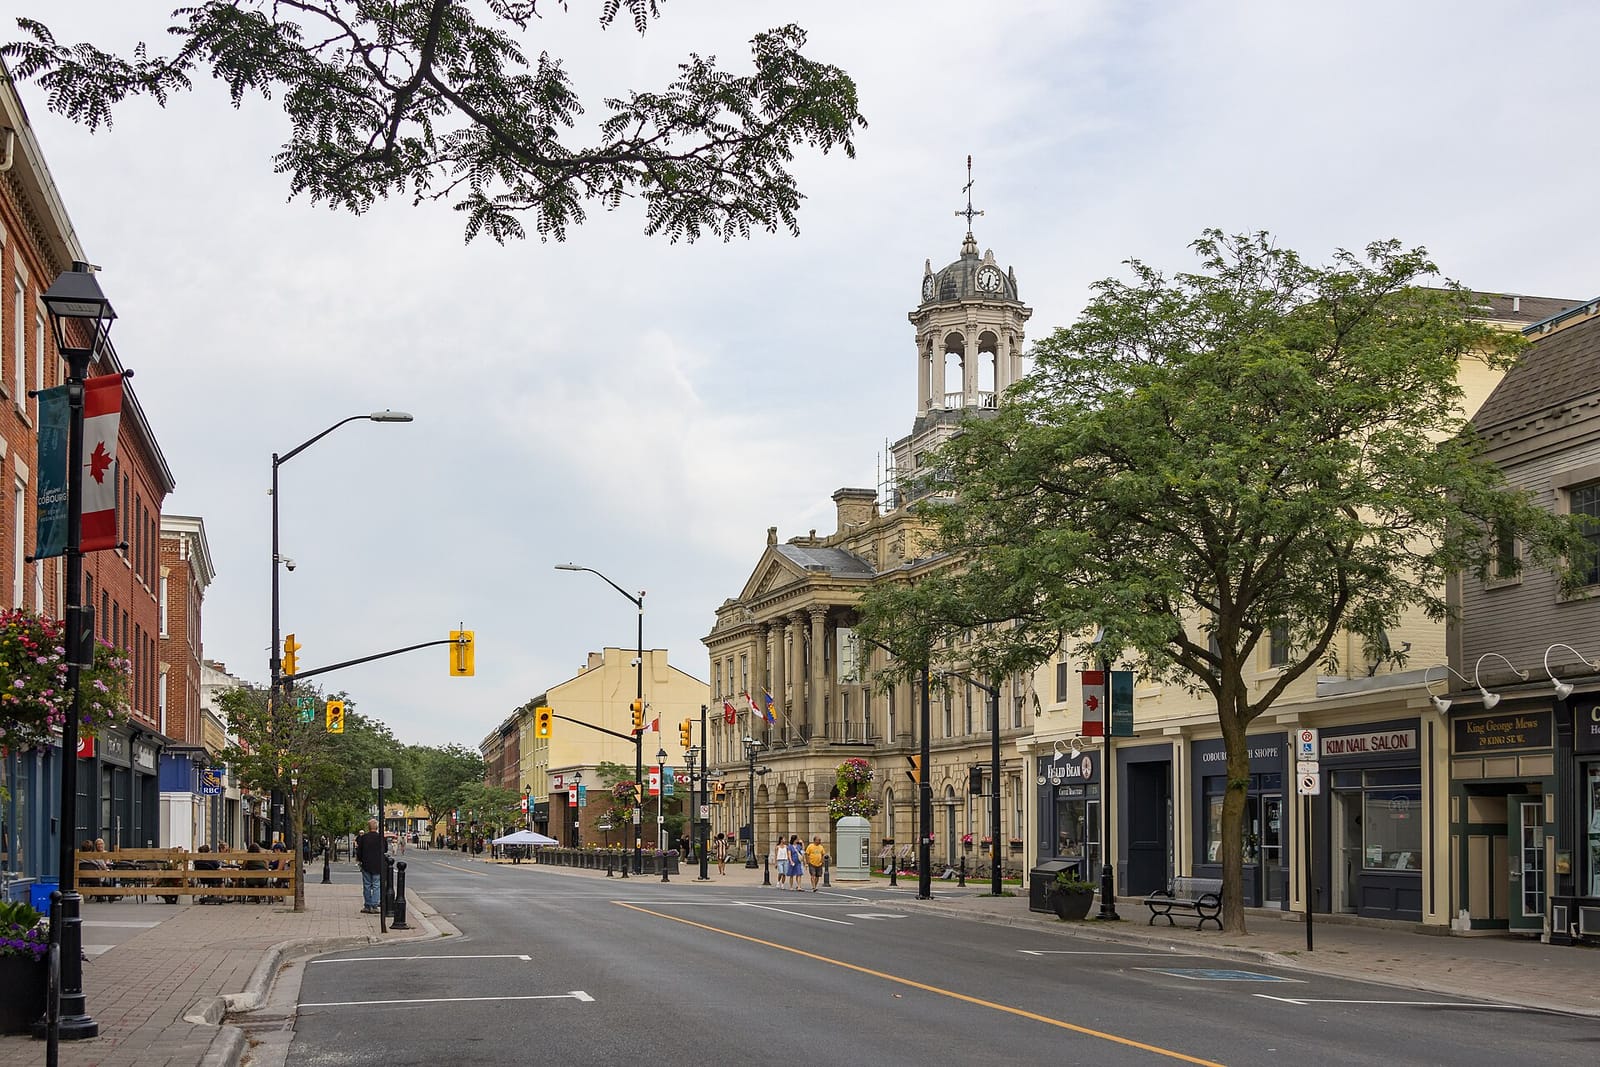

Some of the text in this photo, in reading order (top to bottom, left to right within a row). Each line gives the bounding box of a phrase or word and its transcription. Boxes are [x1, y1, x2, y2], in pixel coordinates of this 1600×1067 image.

[1466, 717, 1538, 735] King George Mews
[1326, 734, 1408, 754] KIM NAIL SALON
[1487, 736, 1506, 745] KING
[1254, 747, 1279, 759] SHOPPE
